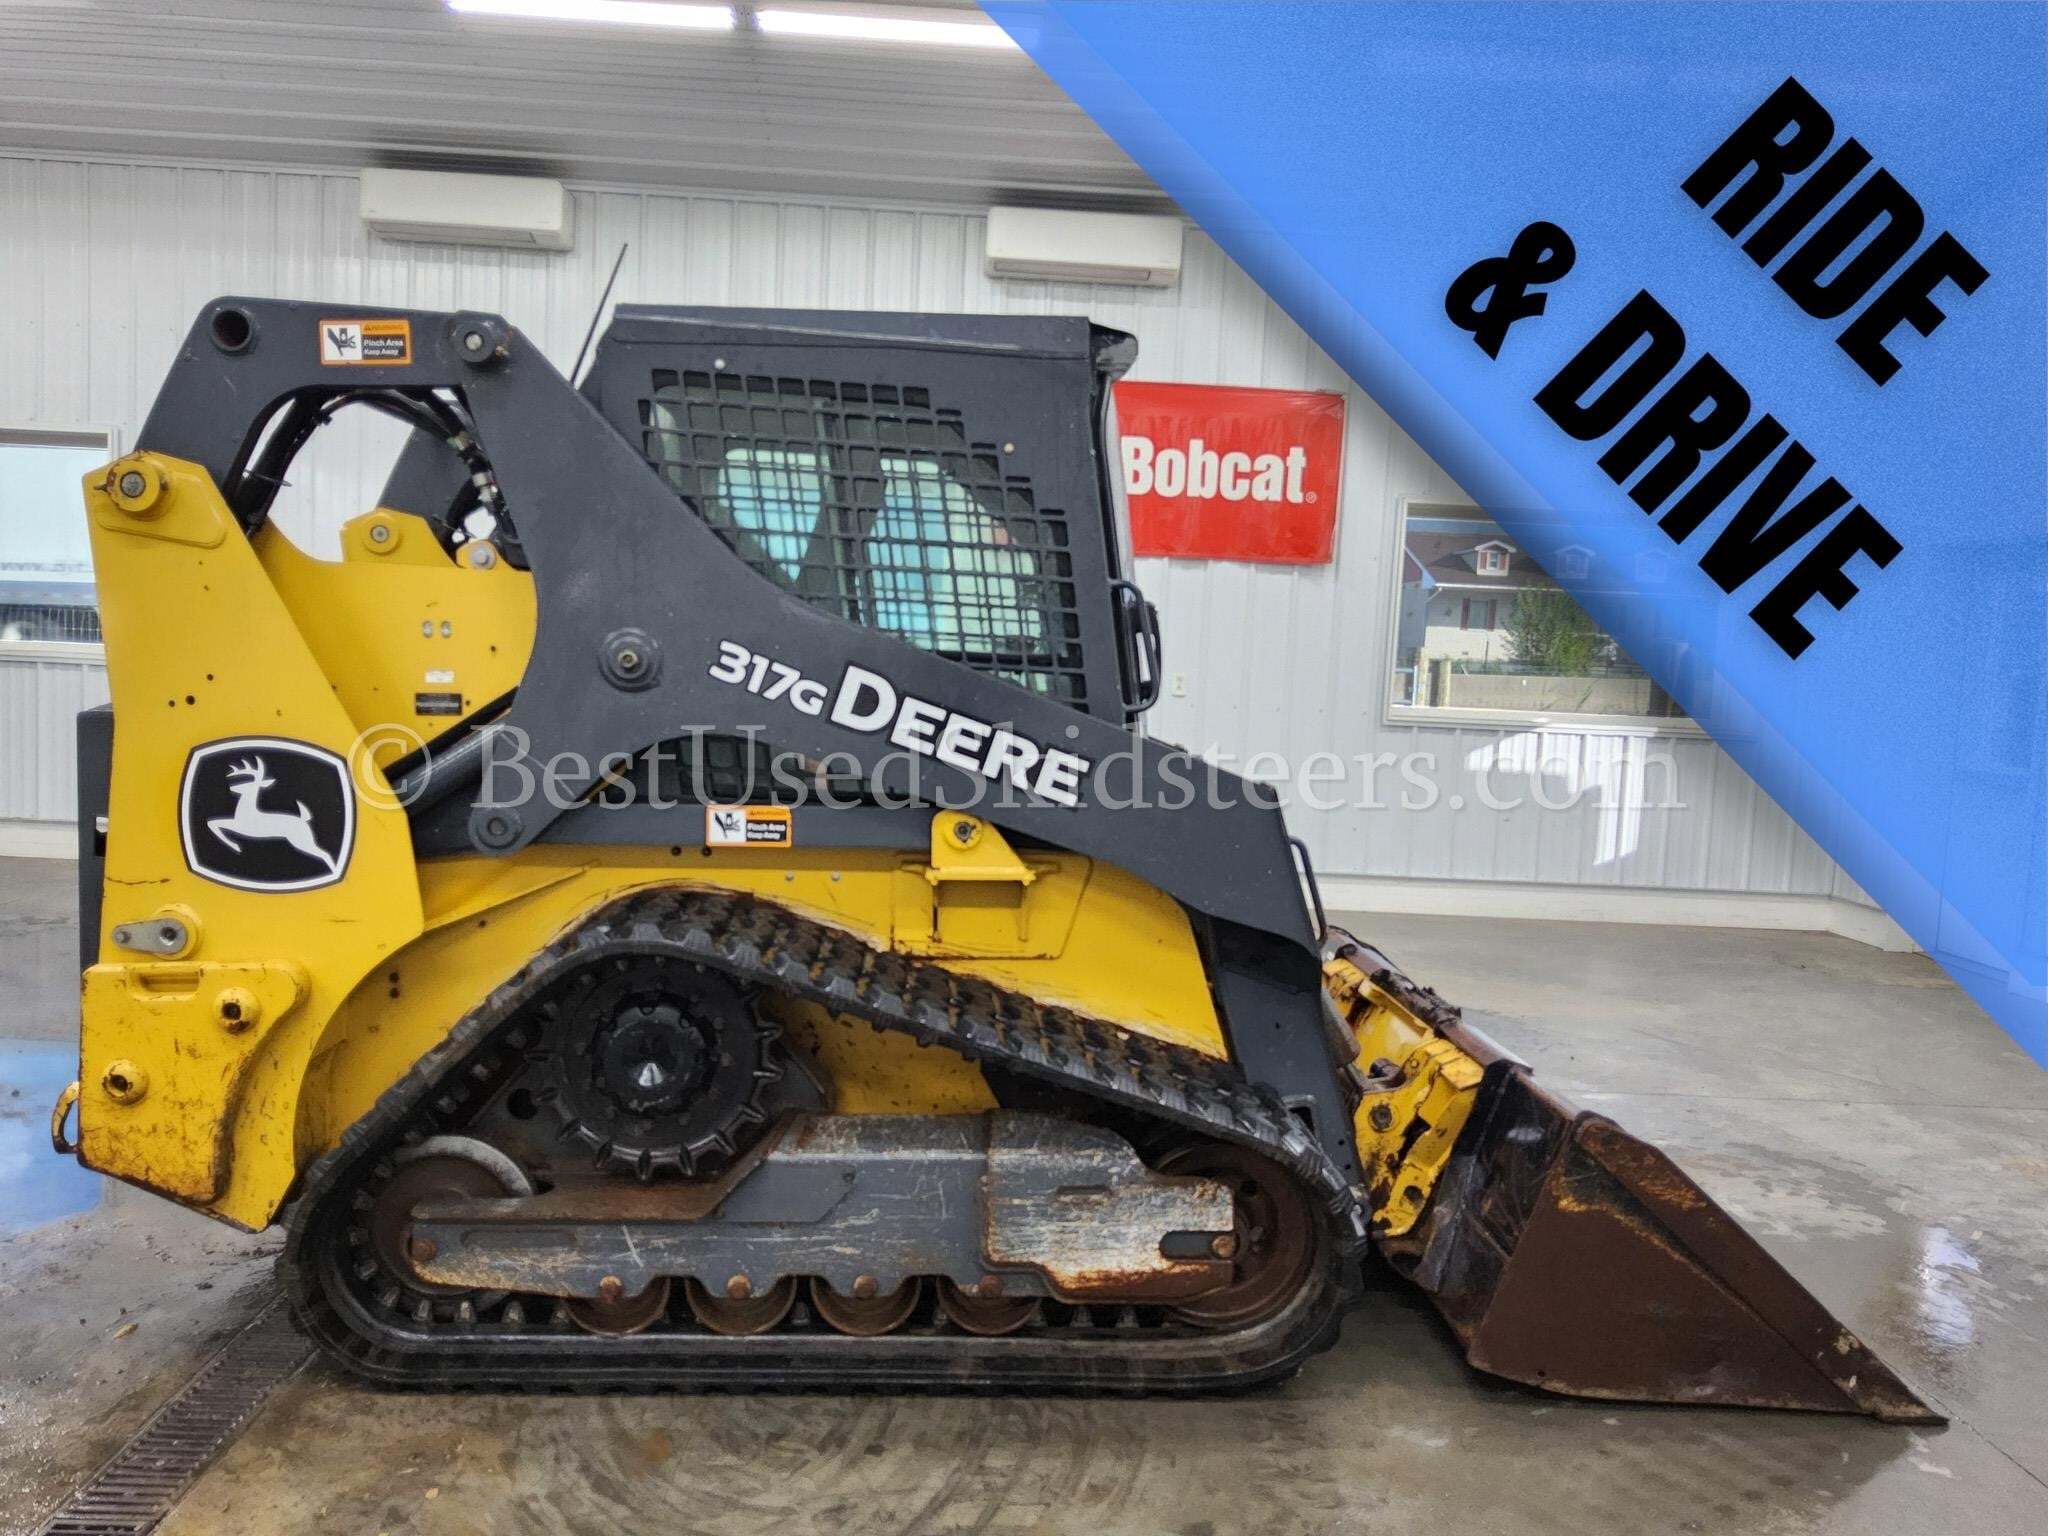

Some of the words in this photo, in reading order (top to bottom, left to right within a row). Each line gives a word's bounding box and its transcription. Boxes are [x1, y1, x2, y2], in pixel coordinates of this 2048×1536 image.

[1121, 436, 1307, 504] Bobcat
[708, 639, 828, 717] 317G
[830, 665, 1090, 807] DEERE
